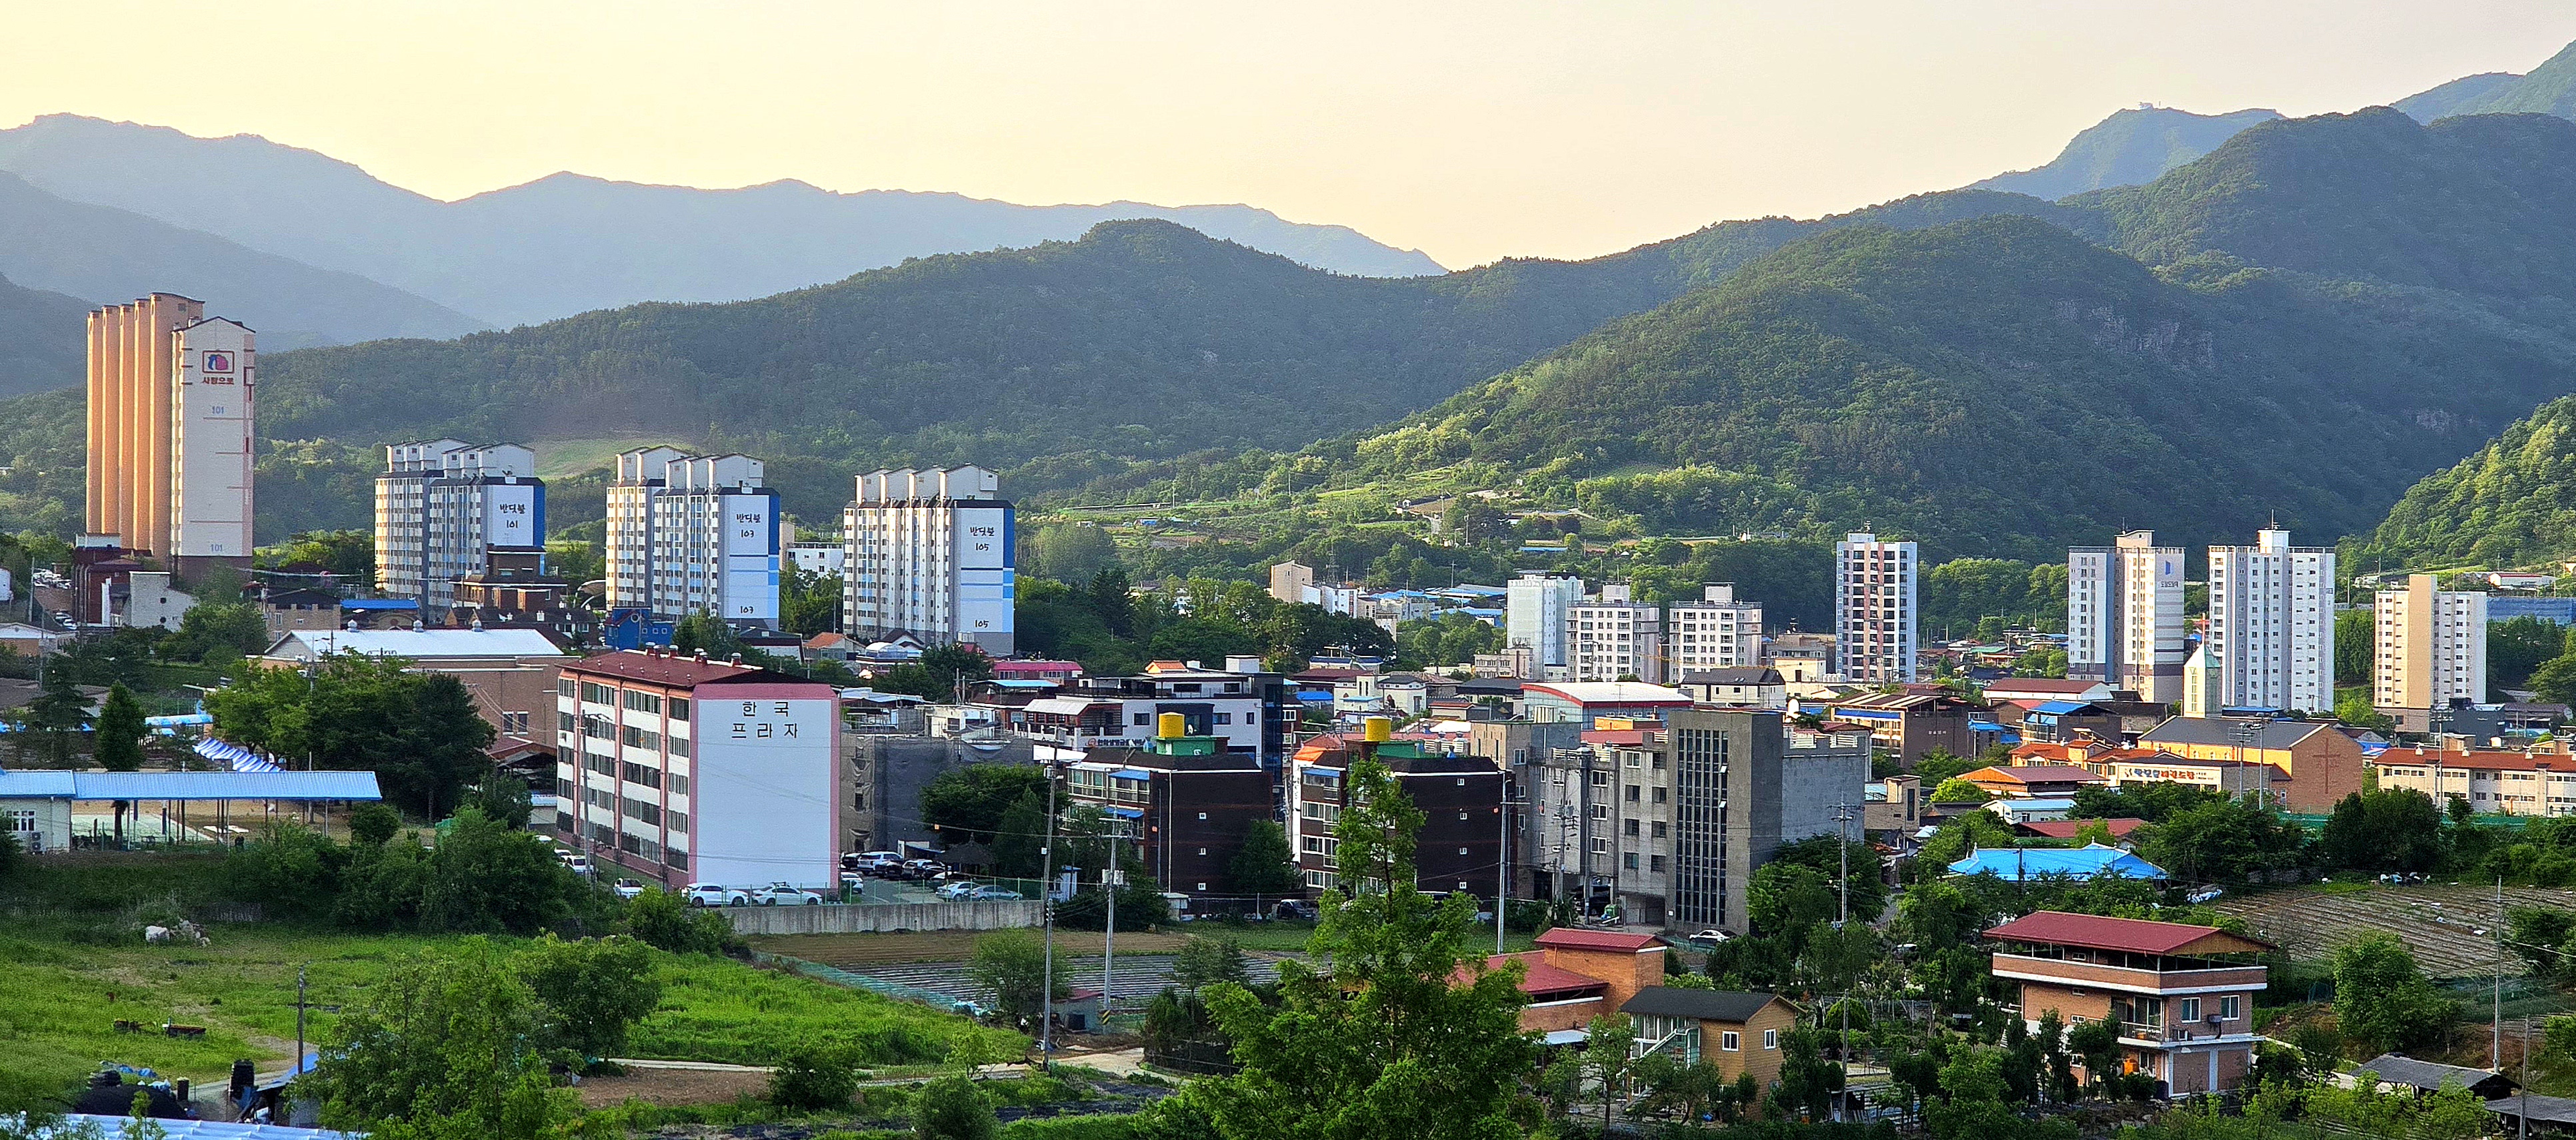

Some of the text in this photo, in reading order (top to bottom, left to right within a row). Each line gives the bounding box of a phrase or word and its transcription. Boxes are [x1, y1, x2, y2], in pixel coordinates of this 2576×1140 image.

[212, 406, 225, 415] 101
[499, 503, 525, 514] 반딧불
[736, 513, 761, 523] 반딧불
[507, 520, 518, 529] 101
[741, 529, 755, 537] 103
[970, 527, 995, 537] 반딧불
[210, 544, 223, 552] 101
[975, 543, 989, 551] 105
[740, 605, 754, 614] 103
[975, 619, 989, 628] 105
